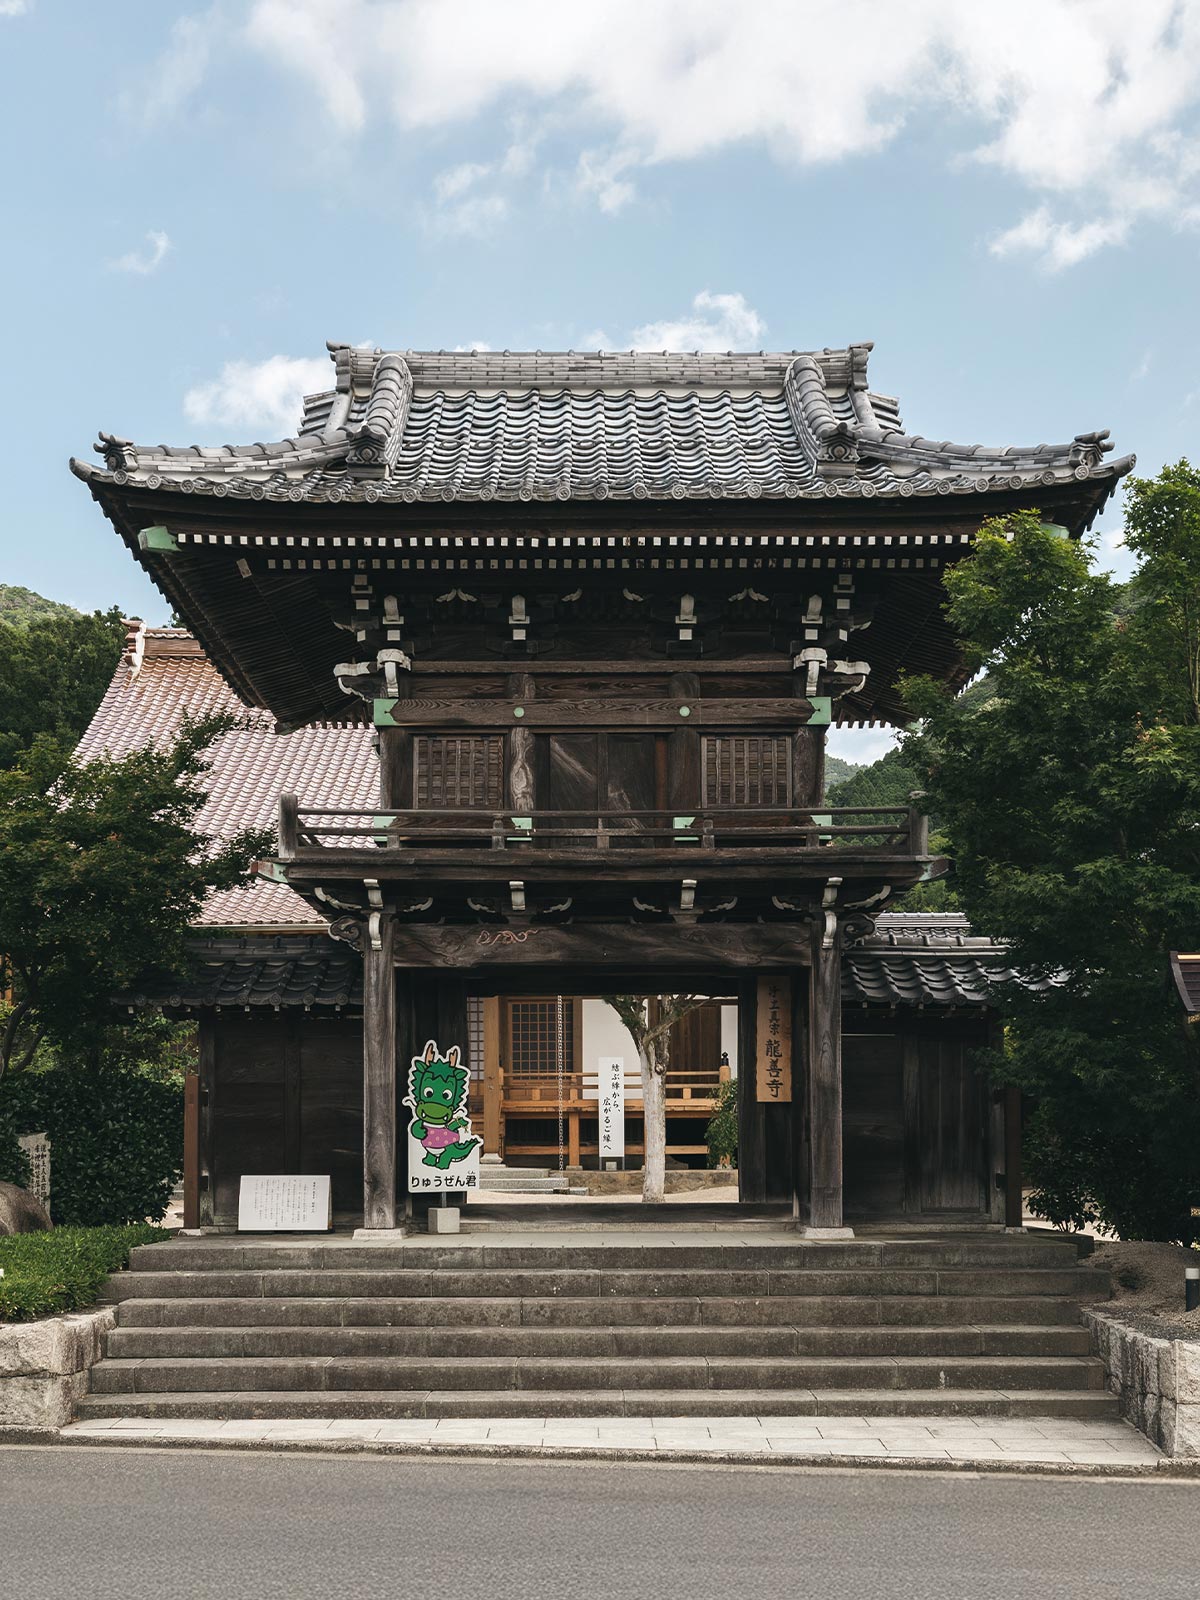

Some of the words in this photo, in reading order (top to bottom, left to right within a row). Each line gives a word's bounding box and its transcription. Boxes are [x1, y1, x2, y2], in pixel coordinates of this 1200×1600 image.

[765, 1039, 784, 1098] 龍善寺
[412, 1175, 476, 1187] りゅうぜん君
